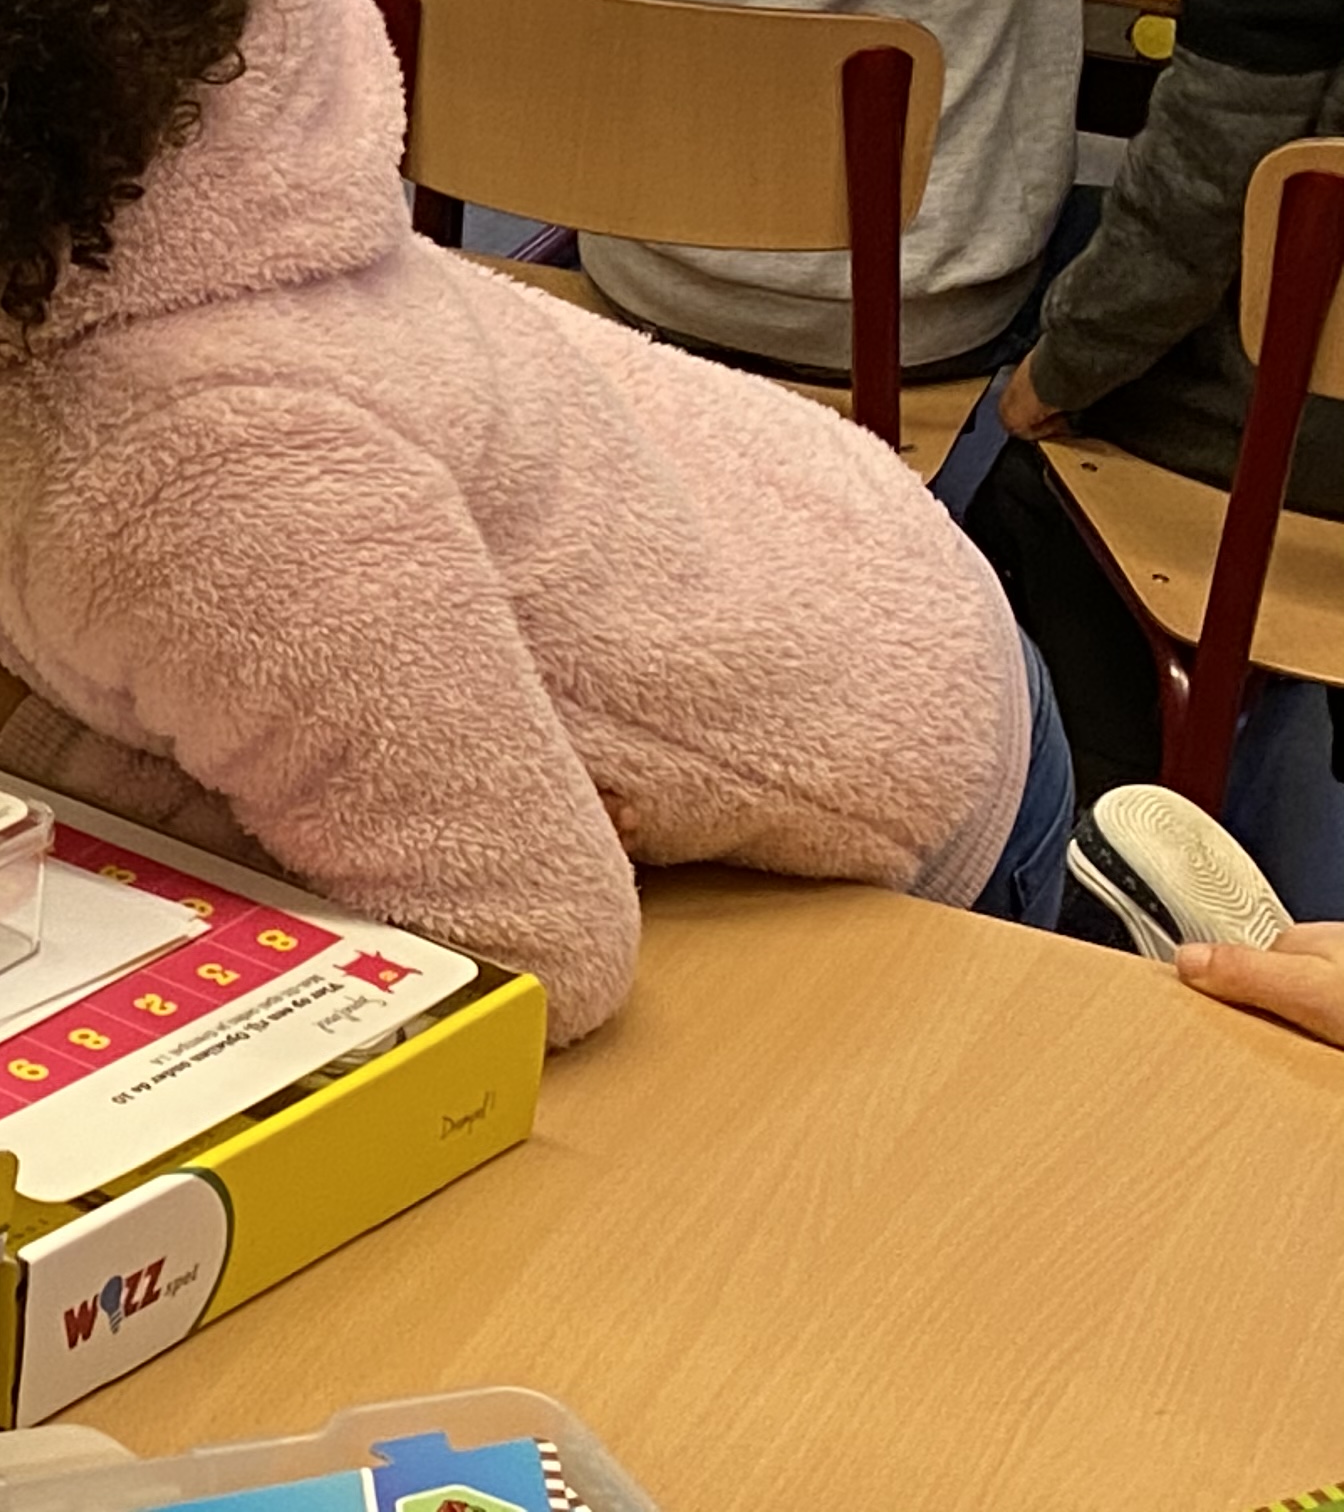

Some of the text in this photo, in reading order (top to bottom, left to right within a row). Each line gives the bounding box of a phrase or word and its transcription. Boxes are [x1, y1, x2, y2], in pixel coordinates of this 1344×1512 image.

[256, 929, 299, 952] 8
[266, 1007, 295, 1021] een
[67, 1028, 112, 1051] 8
[111, 1092, 134, 1104] 10
[63, 1256, 201, 1351] WIZZ spel
